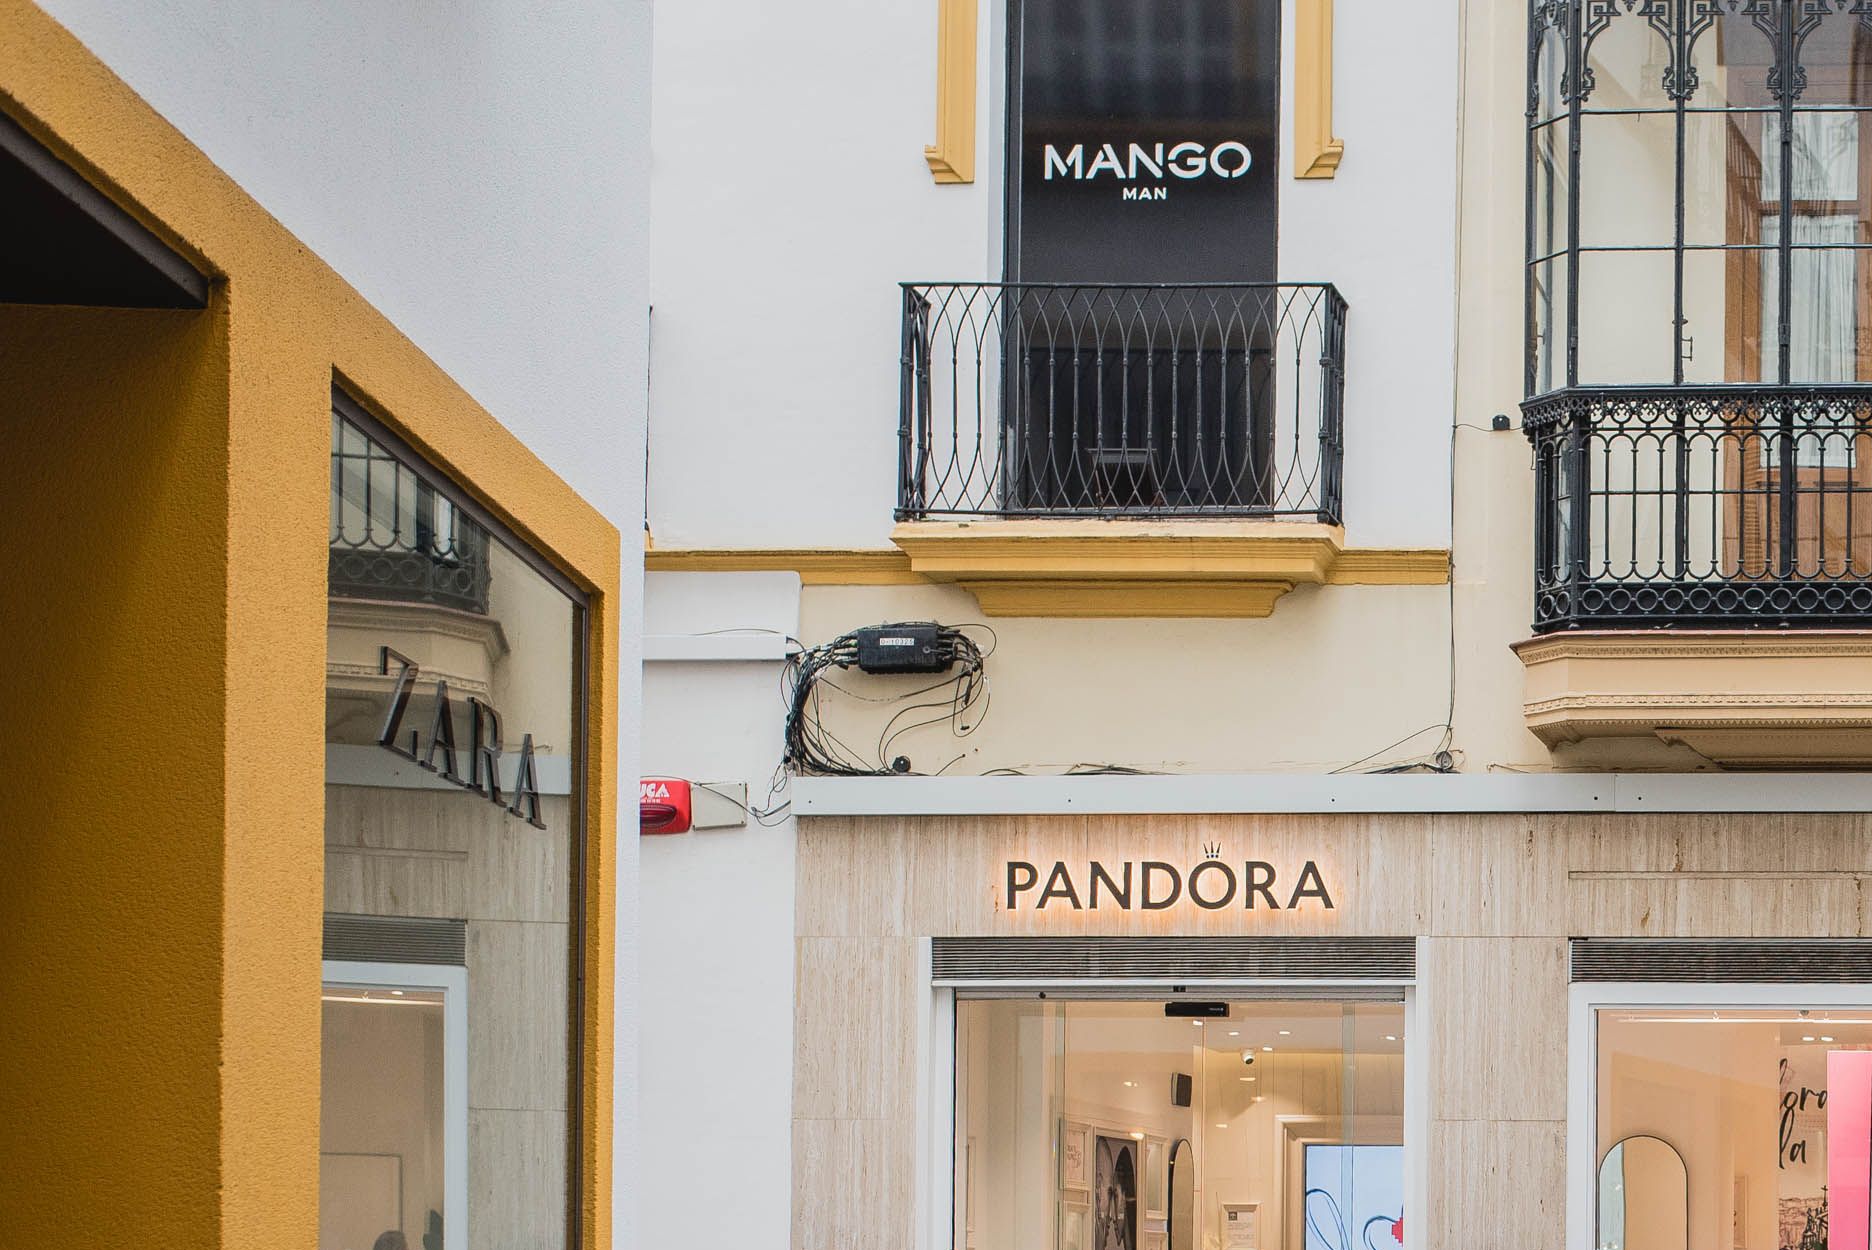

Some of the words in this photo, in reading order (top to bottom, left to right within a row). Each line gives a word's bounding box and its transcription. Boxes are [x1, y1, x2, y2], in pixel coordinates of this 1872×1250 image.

[1044, 141, 1252, 180] MANGO
[1122, 186, 1167, 200] MAN
[377, 645, 547, 831] ZARA
[1006, 860, 1336, 911] PANDORA
